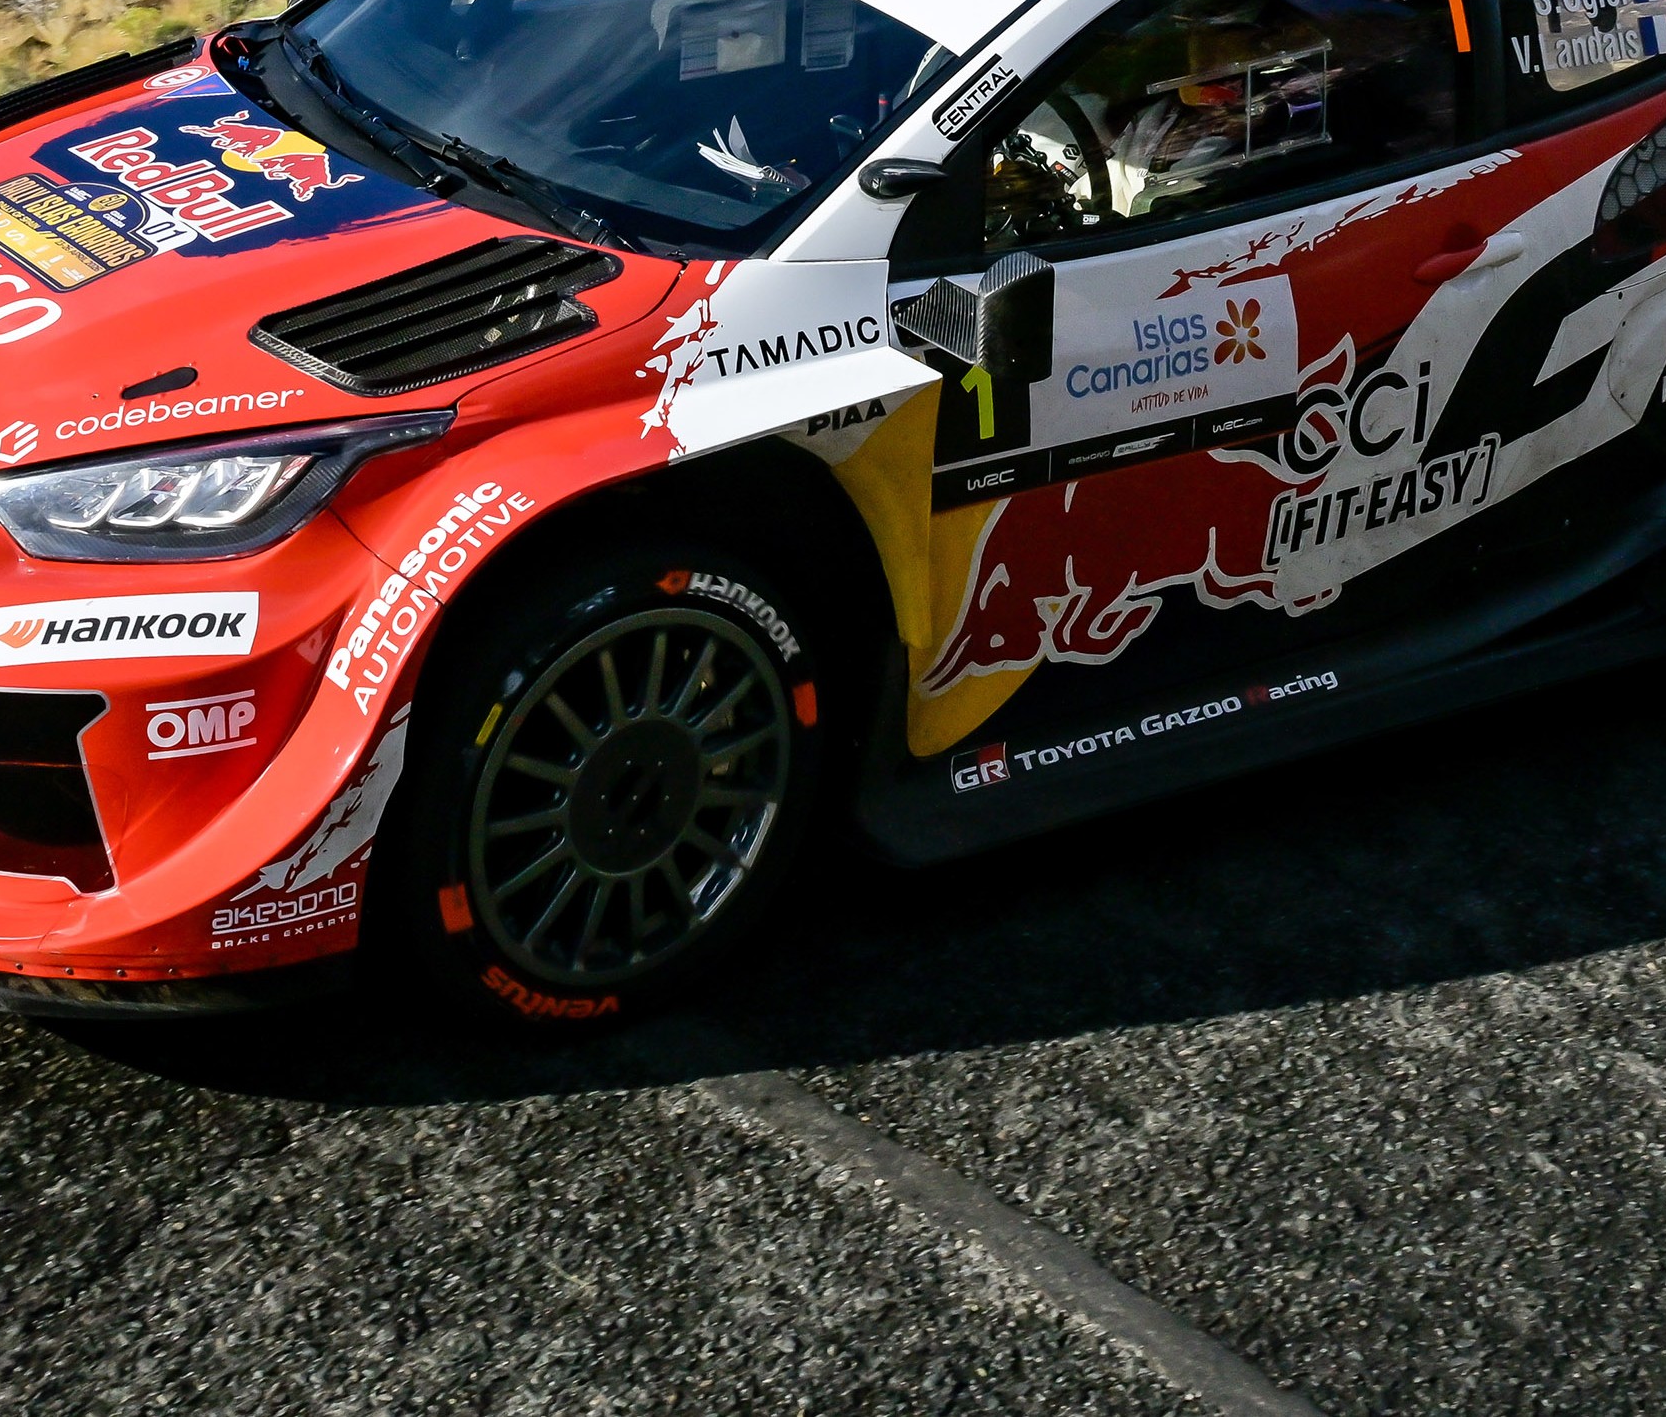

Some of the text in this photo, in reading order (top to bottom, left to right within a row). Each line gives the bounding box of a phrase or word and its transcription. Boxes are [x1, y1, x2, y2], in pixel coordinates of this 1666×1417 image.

[936, 62, 1015, 135] CENTRAL
[22, 193, 84, 226] ISLAS
[56, 214, 146, 267] CANARIAS
[141, 221, 188, 243] 01
[706, 315, 881, 377] TAMADIC
[1133, 313, 1208, 352] Islas
[1066, 346, 1209, 399] Canarias
[806, 398, 888, 436] PIAA
[960, 364, 995, 440] 1
[1131, 384, 1209, 413] LATITUD DE VIDA
[1069, 440, 1153, 465] BEYOND RALLY
[967, 468, 1016, 491] WRC
[325, 482, 504, 692] Panasonic
[353, 491, 537, 717] AUTOMOTIVE
[146, 701, 256, 748] OMP
[954, 671, 1339, 790] GR TOYOTA GAZOO Racing
[212, 882, 358, 930] akebono
[211, 912, 358, 950] BRAKE EXPERTS
